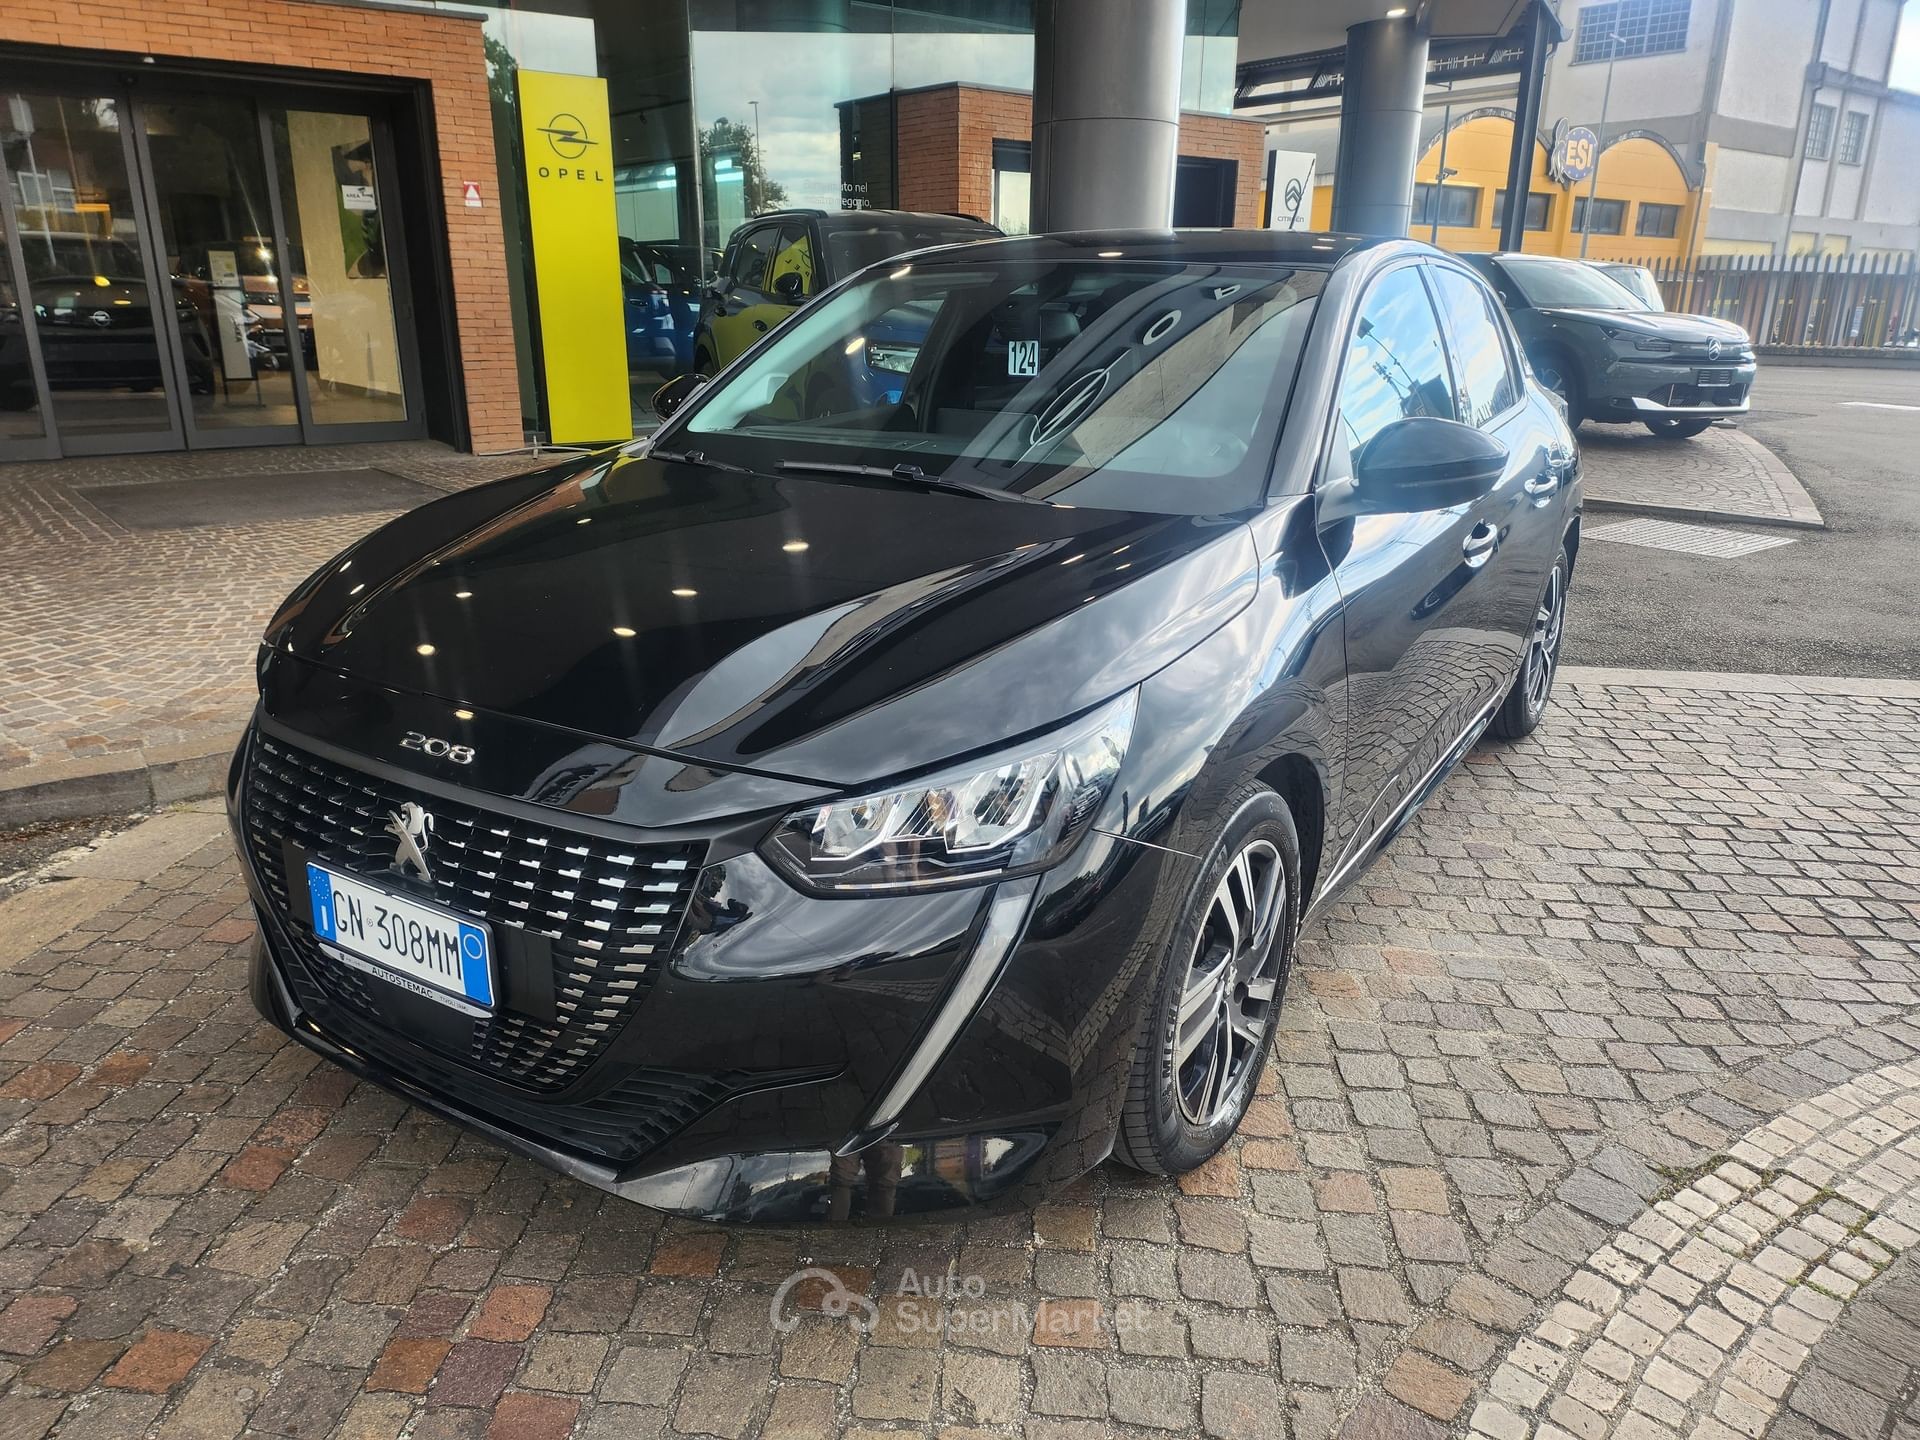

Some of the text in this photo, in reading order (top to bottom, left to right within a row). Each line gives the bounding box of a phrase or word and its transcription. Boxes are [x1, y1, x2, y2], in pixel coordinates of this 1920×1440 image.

[1565, 138, 1594, 170] ESI
[538, 166, 604, 182] OPEL
[854, 181, 868, 193] nel
[1011, 341, 1036, 374] 124
[399, 731, 476, 765] 208
[333, 889, 462, 981] GN 308MM
[371, 966, 434, 999] AUTOSTEMAC
